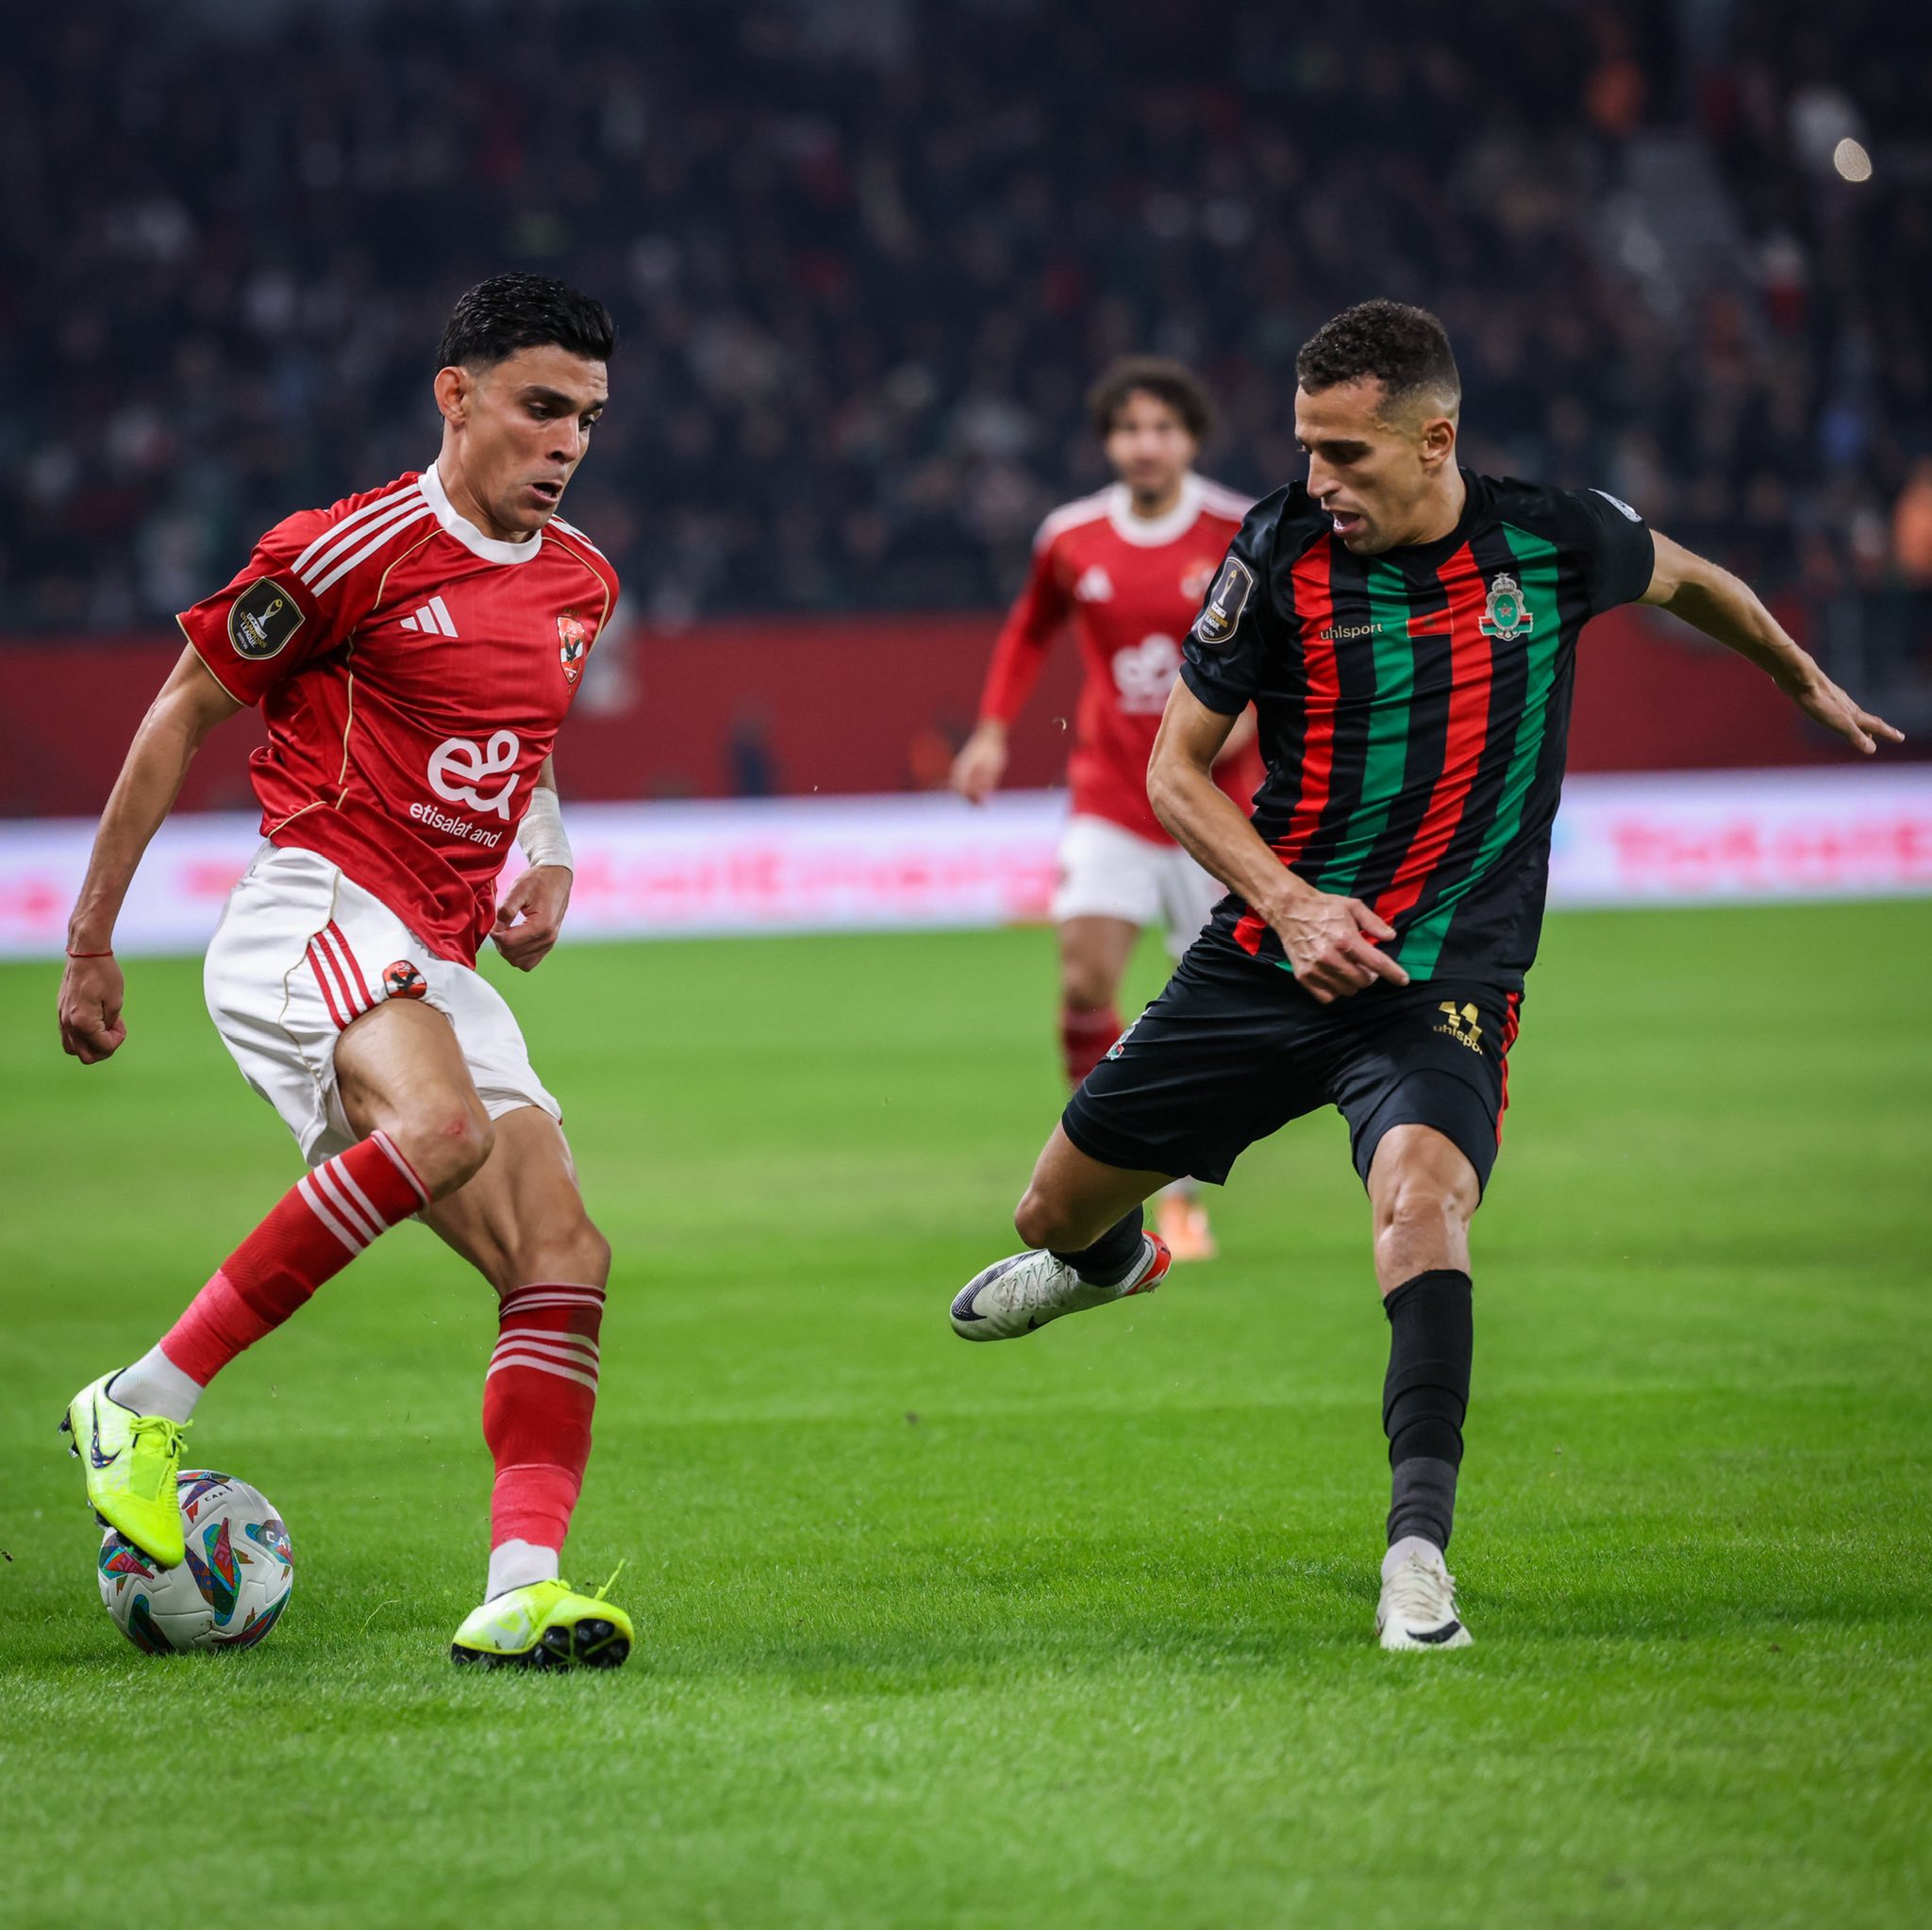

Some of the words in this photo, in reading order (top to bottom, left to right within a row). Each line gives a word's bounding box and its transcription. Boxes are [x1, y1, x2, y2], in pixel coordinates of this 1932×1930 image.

[1320, 624, 1383, 641] uhlsport
[409, 802, 474, 839] etisalat
[470, 827, 503, 848] and
